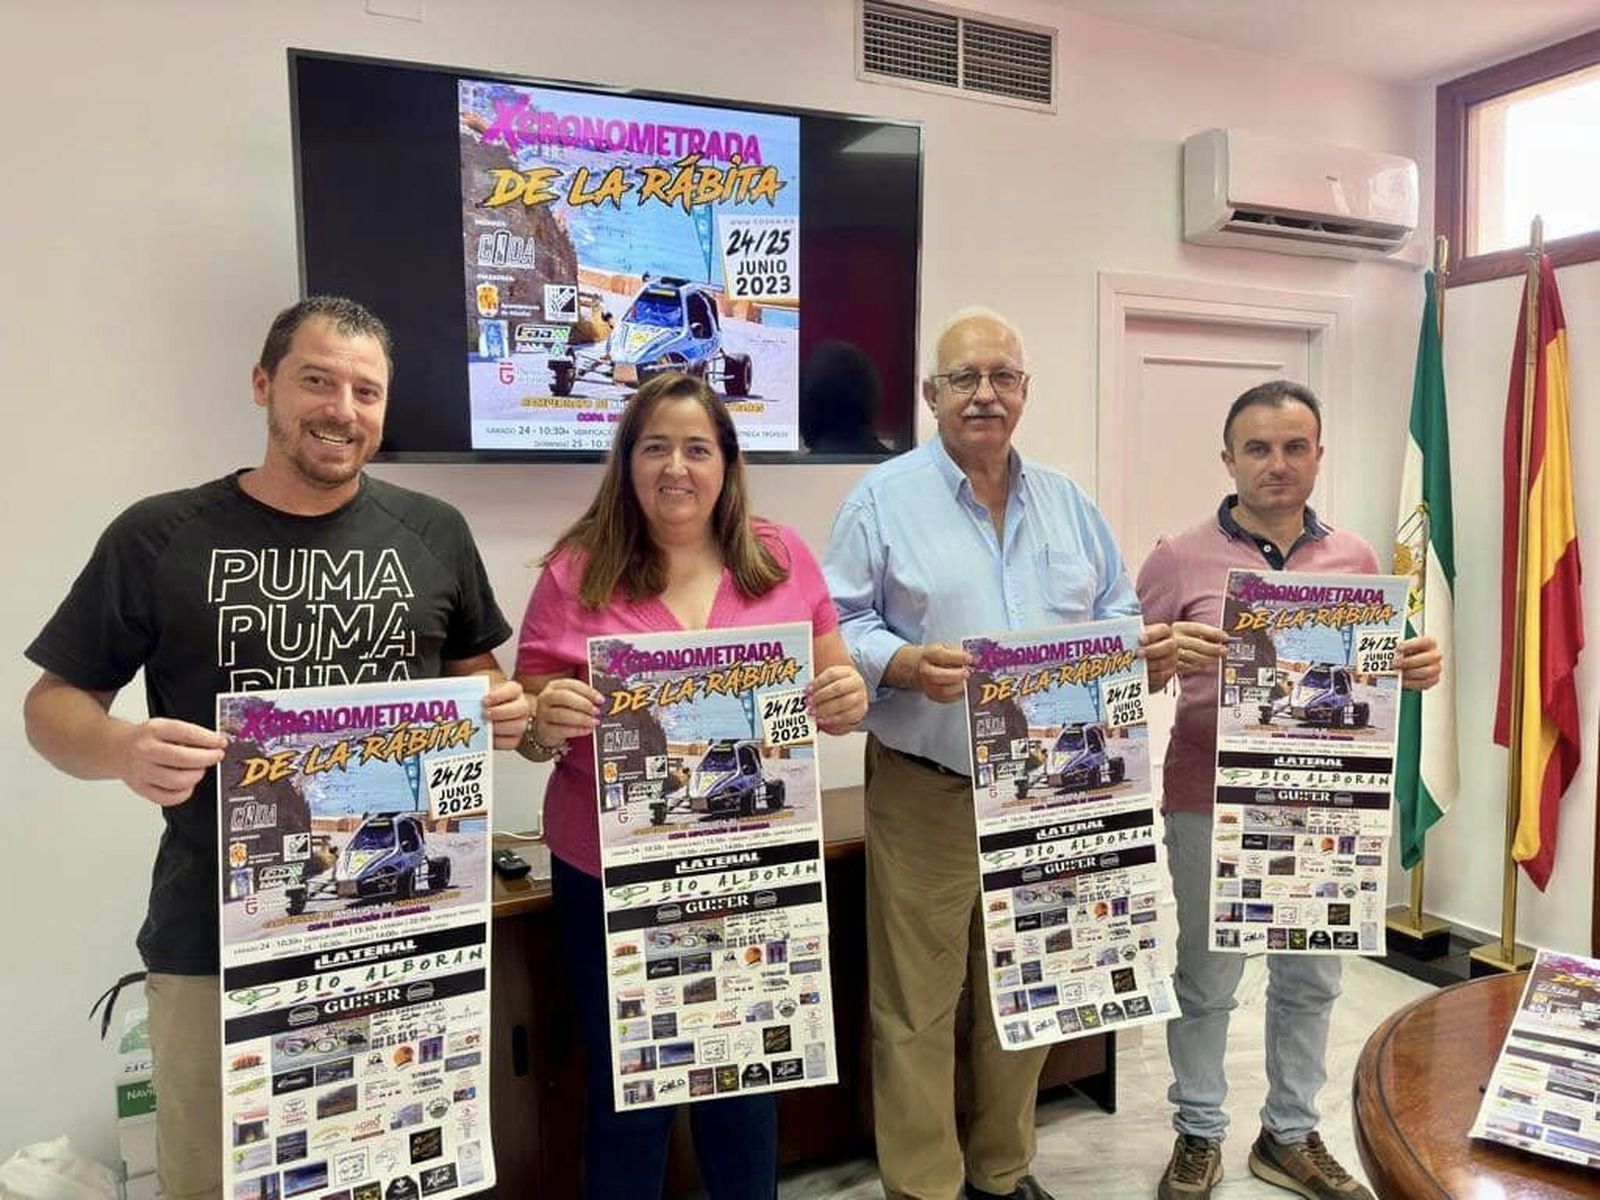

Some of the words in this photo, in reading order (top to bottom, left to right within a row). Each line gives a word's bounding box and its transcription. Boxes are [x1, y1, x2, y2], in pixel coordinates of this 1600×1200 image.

[476, 166, 562, 208] DE
[567, 166, 635, 210] LA
[726, 229, 792, 256] 24/25
[737, 260, 788, 275] JUNIO
[736, 275, 791, 296] 2023
[518, 426, 531, 435] 24
[208, 548, 415, 602] PUMA
[1234, 609, 1271, 632] DE
[1273, 608, 1306, 631] LA
[218, 602, 415, 667] PUMA
[1359, 636, 1399, 651] 24/25
[1363, 653, 1395, 662] JUNIO
[608, 686, 655, 716] DE
[655, 677, 698, 708] LA
[980, 677, 1016, 705] DE
[1018, 671, 1052, 696] LA
[1106, 682, 1142, 705] 24/25
[763, 696, 806, 720] 24/25
[1113, 711, 1144, 726] 2023
[771, 716, 806, 731] JUNIO
[771, 726, 809, 744] 2023
[235, 750, 297, 789] DE
[302, 742, 352, 777] LA
[430, 760, 483, 789] 24/25
[438, 783, 480, 801] JUNIO
[438, 796, 483, 816] 2023
[662, 880, 698, 894] BIO
[295, 976, 340, 994] BIO
